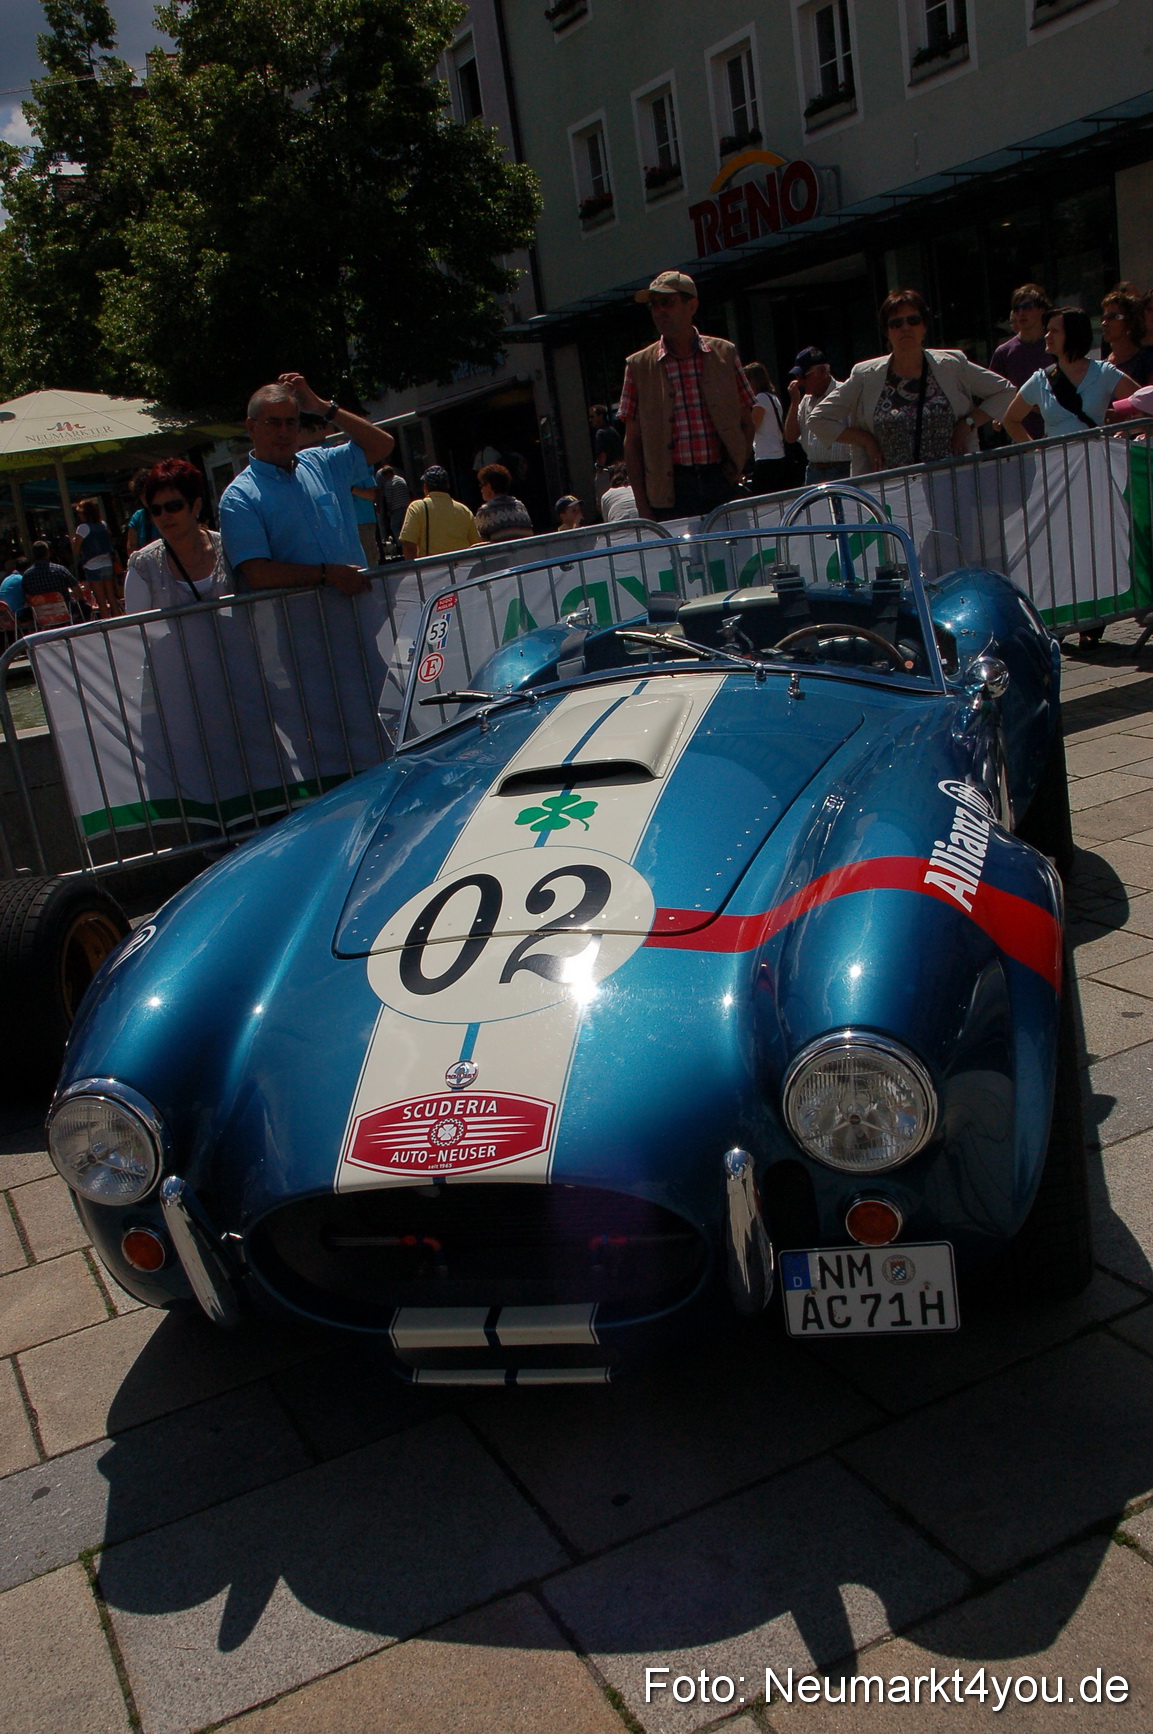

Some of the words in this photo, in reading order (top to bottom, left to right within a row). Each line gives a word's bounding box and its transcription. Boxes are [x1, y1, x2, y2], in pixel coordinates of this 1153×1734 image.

[688, 160, 819, 259] RENO
[25, 425, 114, 443] NEUMARKTER
[429, 621, 447, 641] 53
[423, 658, 438, 678] E
[924, 805, 990, 913] Allianz
[399, 864, 612, 996] 02
[402, 1099, 498, 1120] SCUDERIA
[390, 1145, 497, 1164] AUTO-NEUSER
[818, 1253, 873, 1290] NM
[793, 1276, 803, 1288] D
